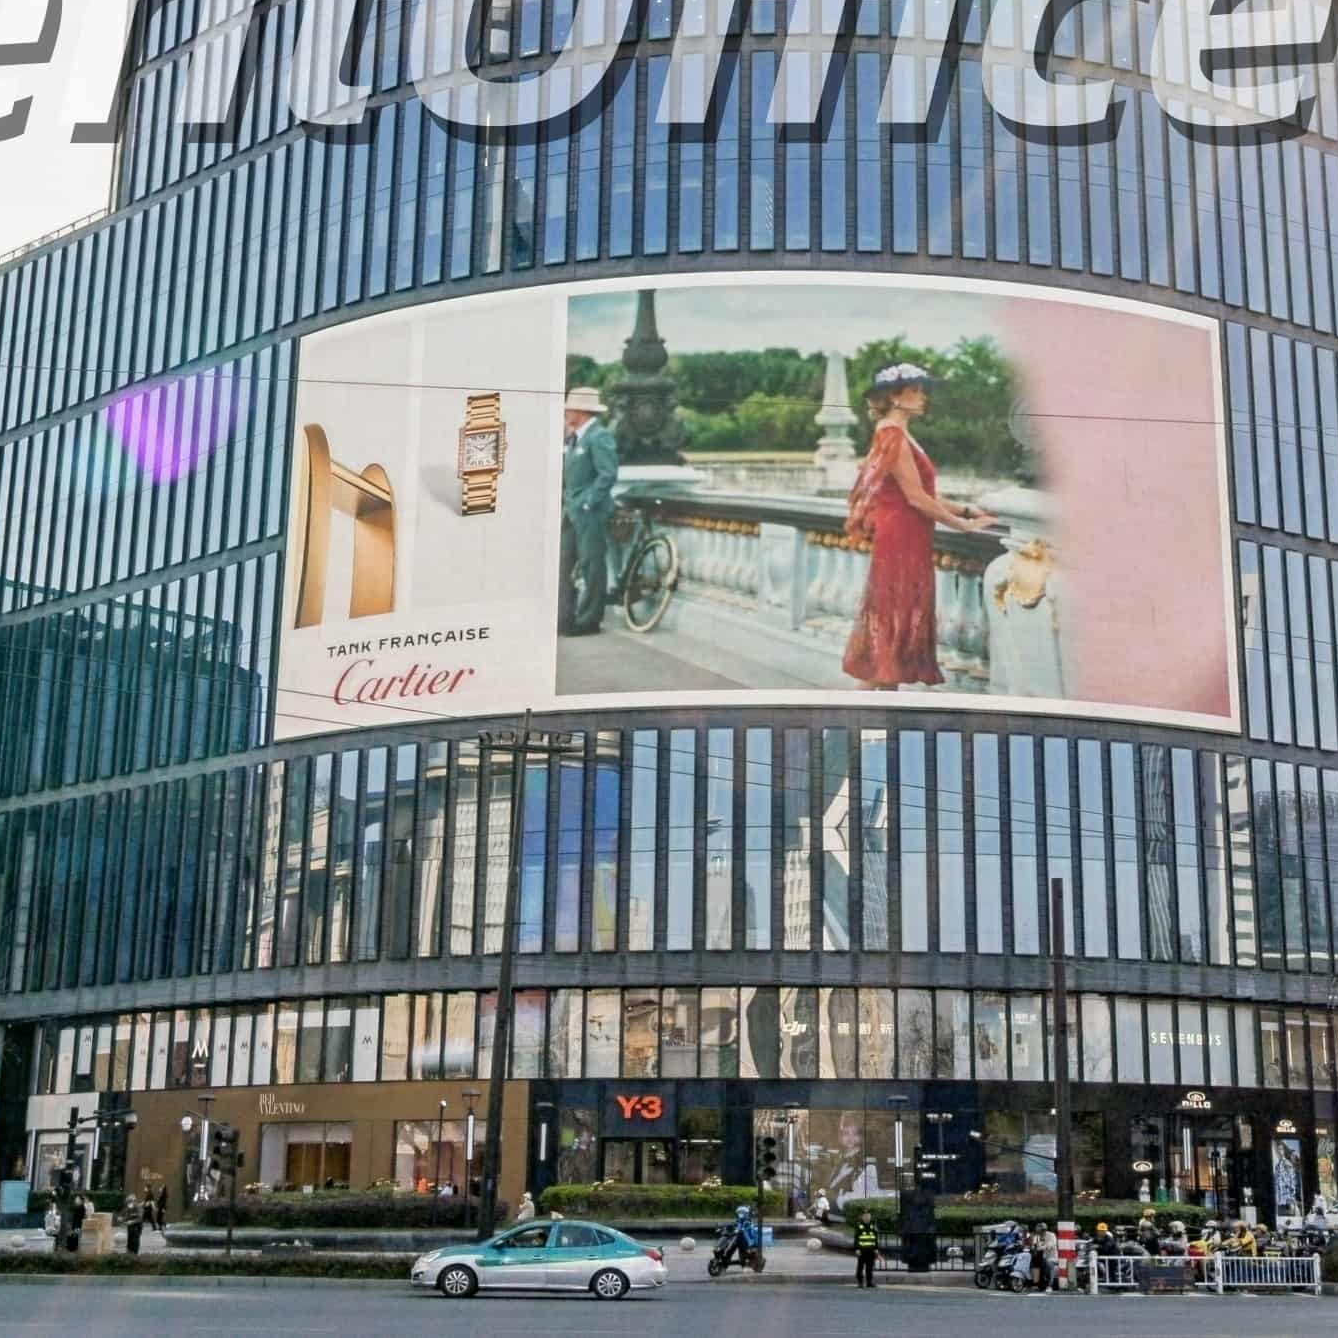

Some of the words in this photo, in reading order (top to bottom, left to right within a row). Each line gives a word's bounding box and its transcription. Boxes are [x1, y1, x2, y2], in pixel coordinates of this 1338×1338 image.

[326, 641, 372, 659] TANK
[378, 627, 491, 652] FRANÇAISE
[332, 659, 476, 706] Cartier
[191, 1040, 209, 1059] M
[616, 1095, 662, 1119] Y-3
